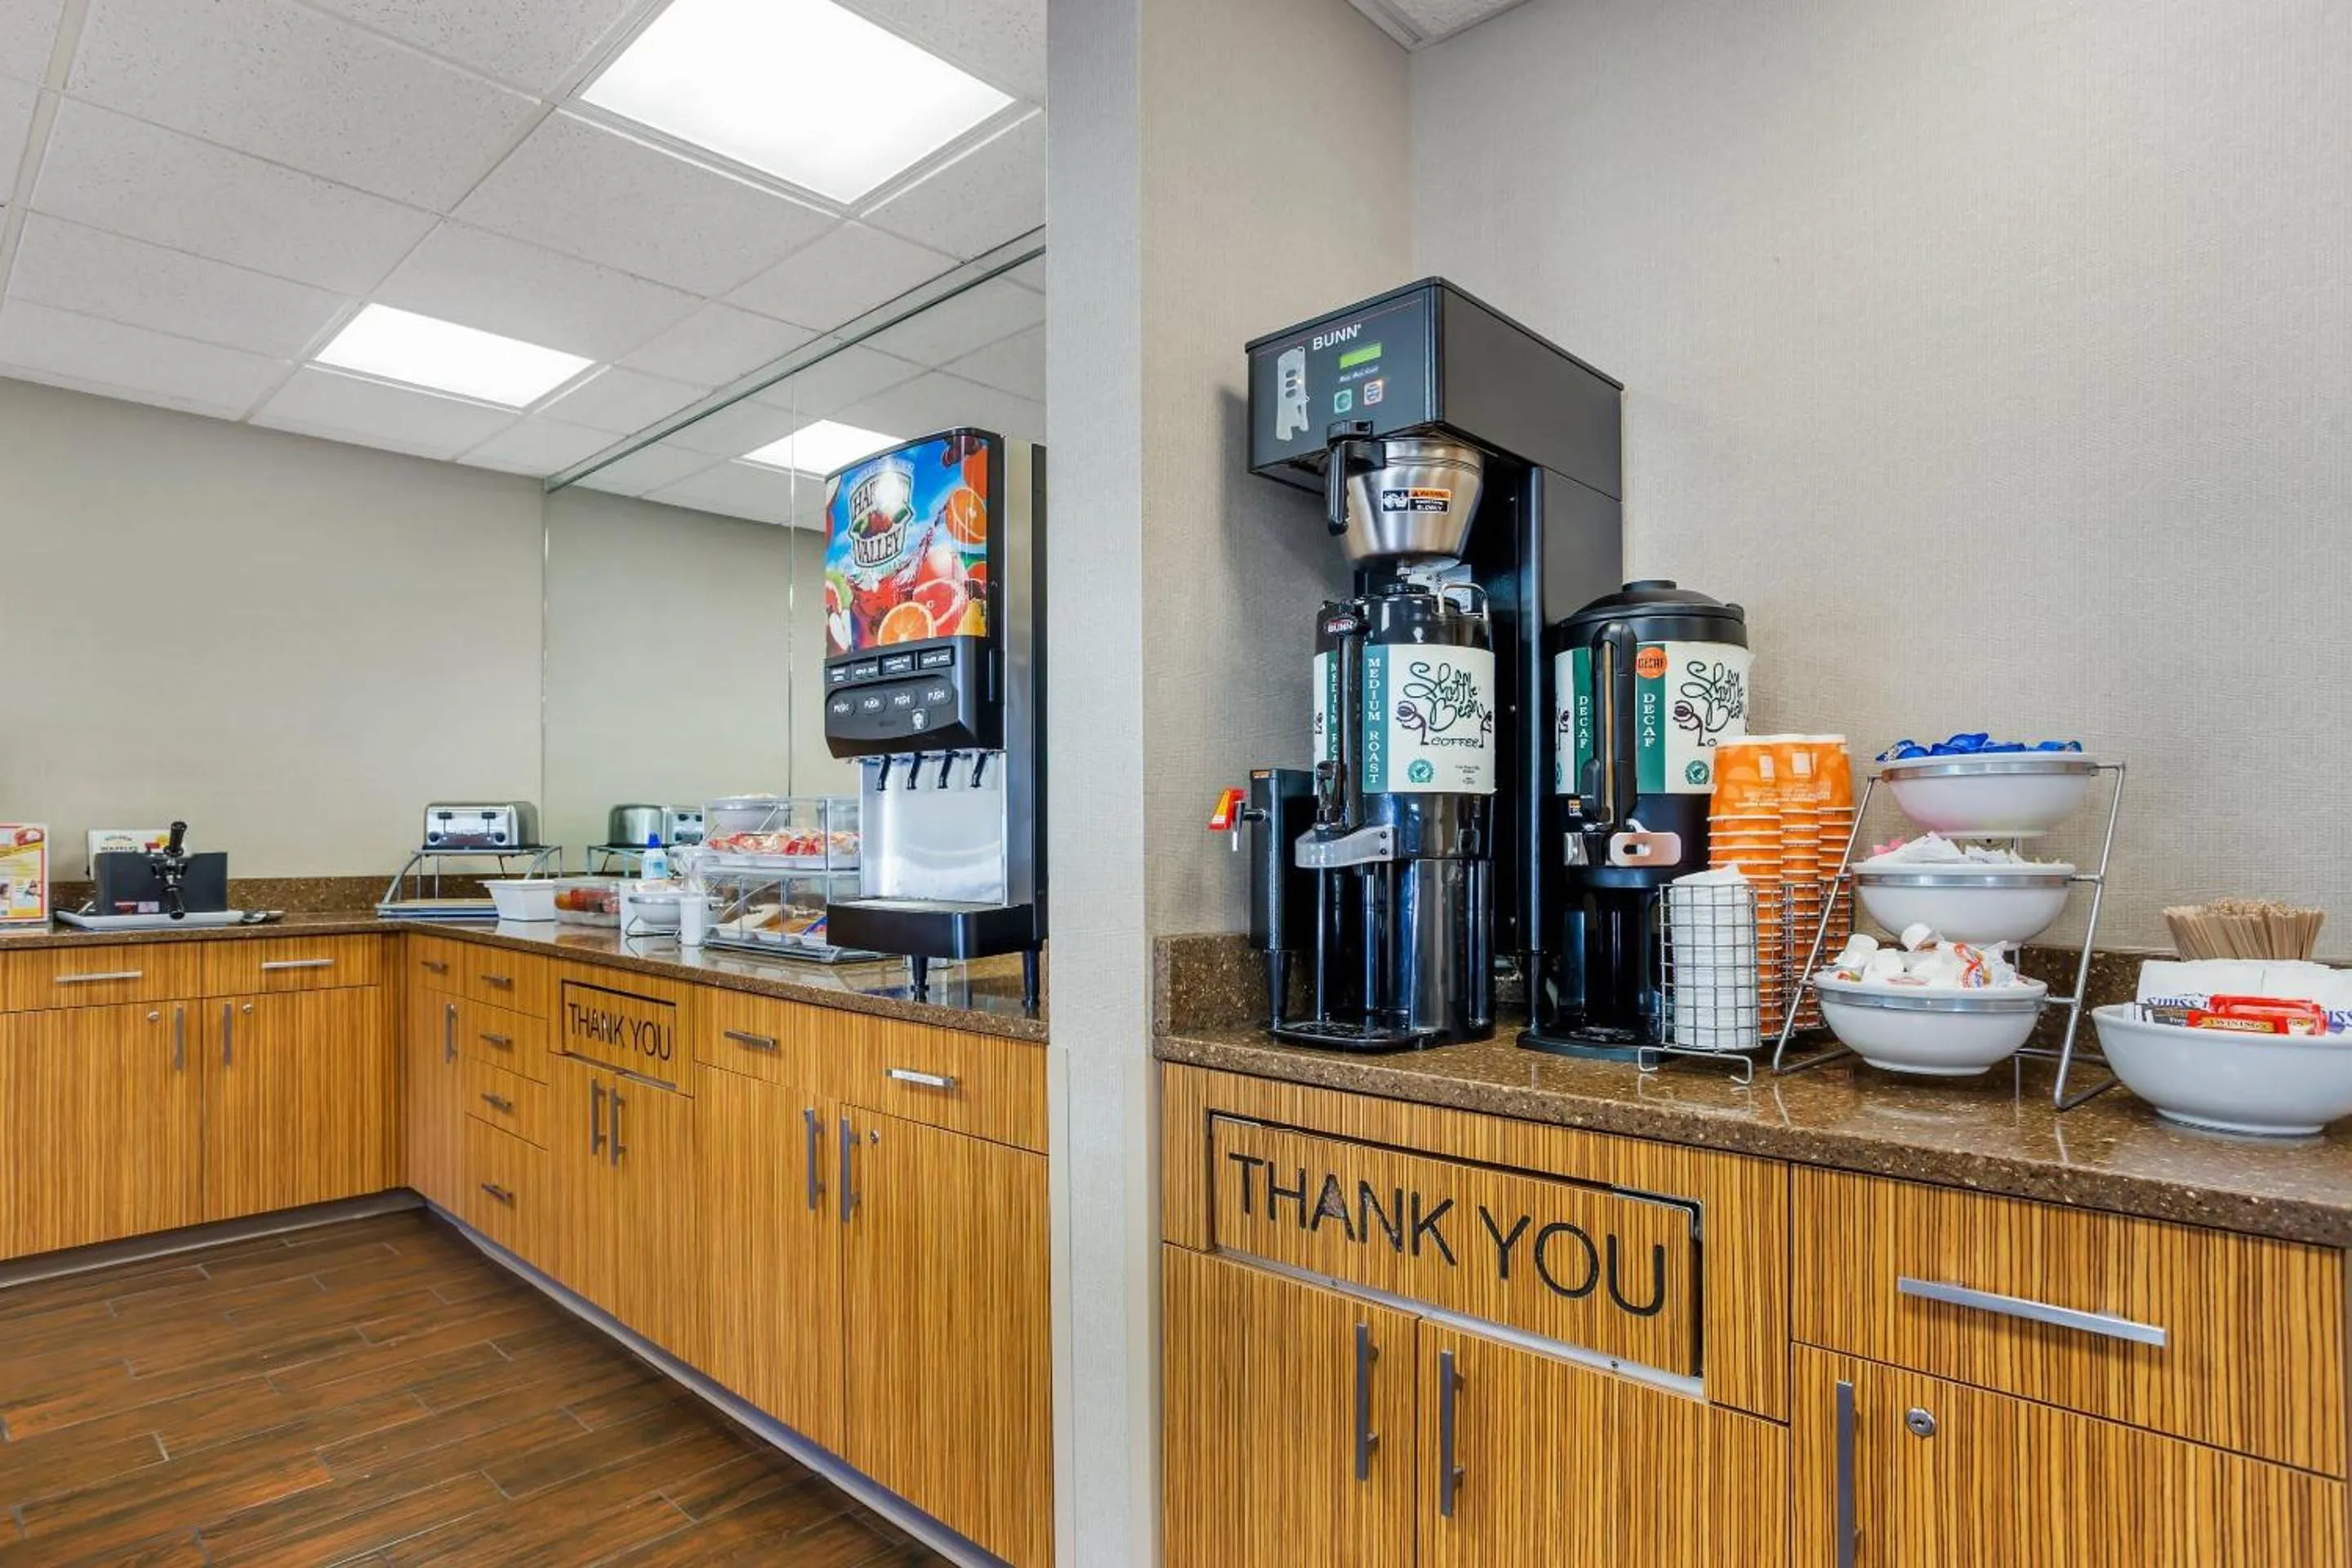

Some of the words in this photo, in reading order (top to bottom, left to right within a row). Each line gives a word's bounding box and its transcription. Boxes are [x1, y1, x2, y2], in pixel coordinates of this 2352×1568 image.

[1312, 324, 1358, 350] BUNN
[856, 528, 902, 564] VALLEY
[1367, 658, 1381, 720] MEDIUM
[1431, 737, 1479, 748] COFFEE
[1579, 696, 1589, 748] DECAF
[1643, 693, 1656, 746] DECAF
[1368, 731, 1380, 783] ROAST
[568, 1003, 625, 1049] THANK
[629, 1018, 670, 1062] YOU
[1228, 1152, 1456, 1266] THANK
[1479, 1205, 1665, 1316] YOU
